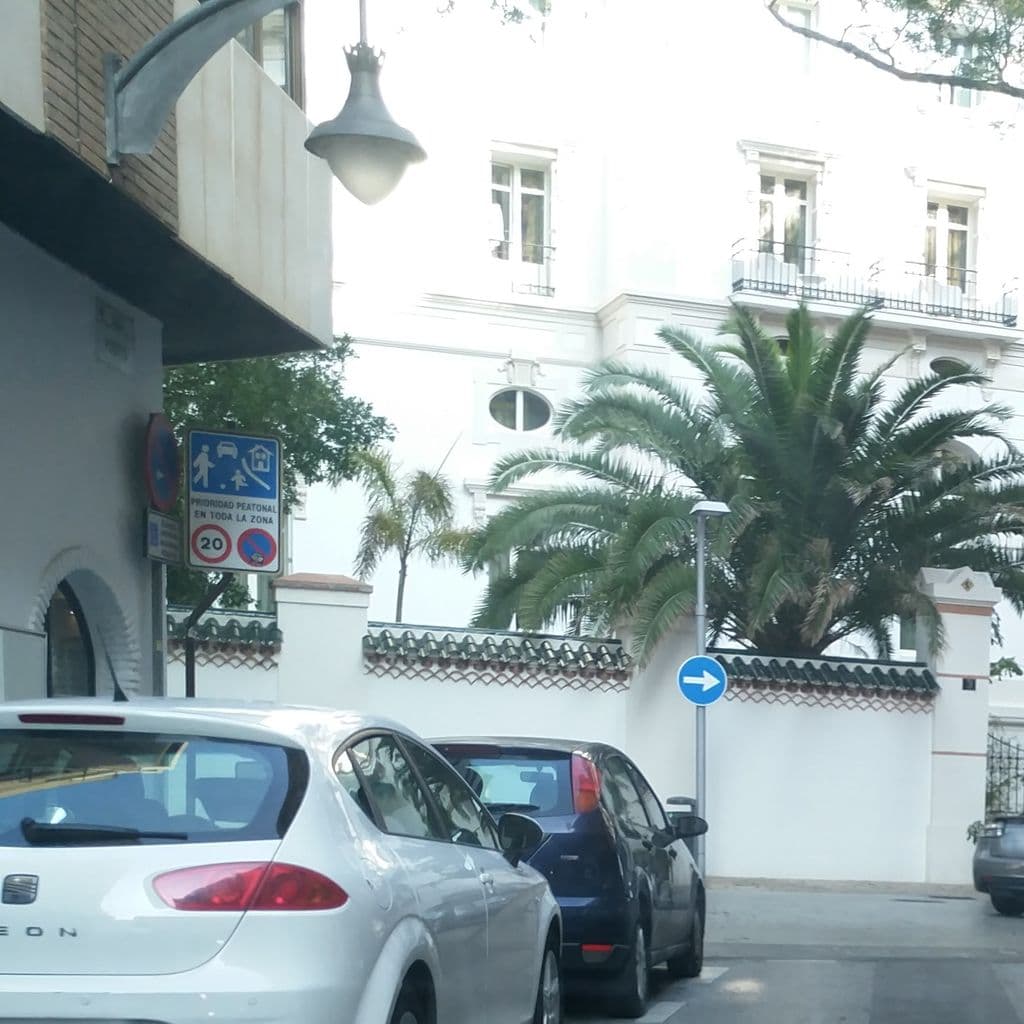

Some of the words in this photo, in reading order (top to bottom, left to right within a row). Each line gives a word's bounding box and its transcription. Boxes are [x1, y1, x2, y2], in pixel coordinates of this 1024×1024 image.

[191, 498, 234, 510] PRIORIDAD
[236, 502, 277, 514] PEATONAL
[194, 510, 206, 519] EN
[210, 511, 233, 521] TODA
[236, 514, 247, 522] LA
[250, 515, 273, 524] ZONA
[200, 537, 223, 550] 20
